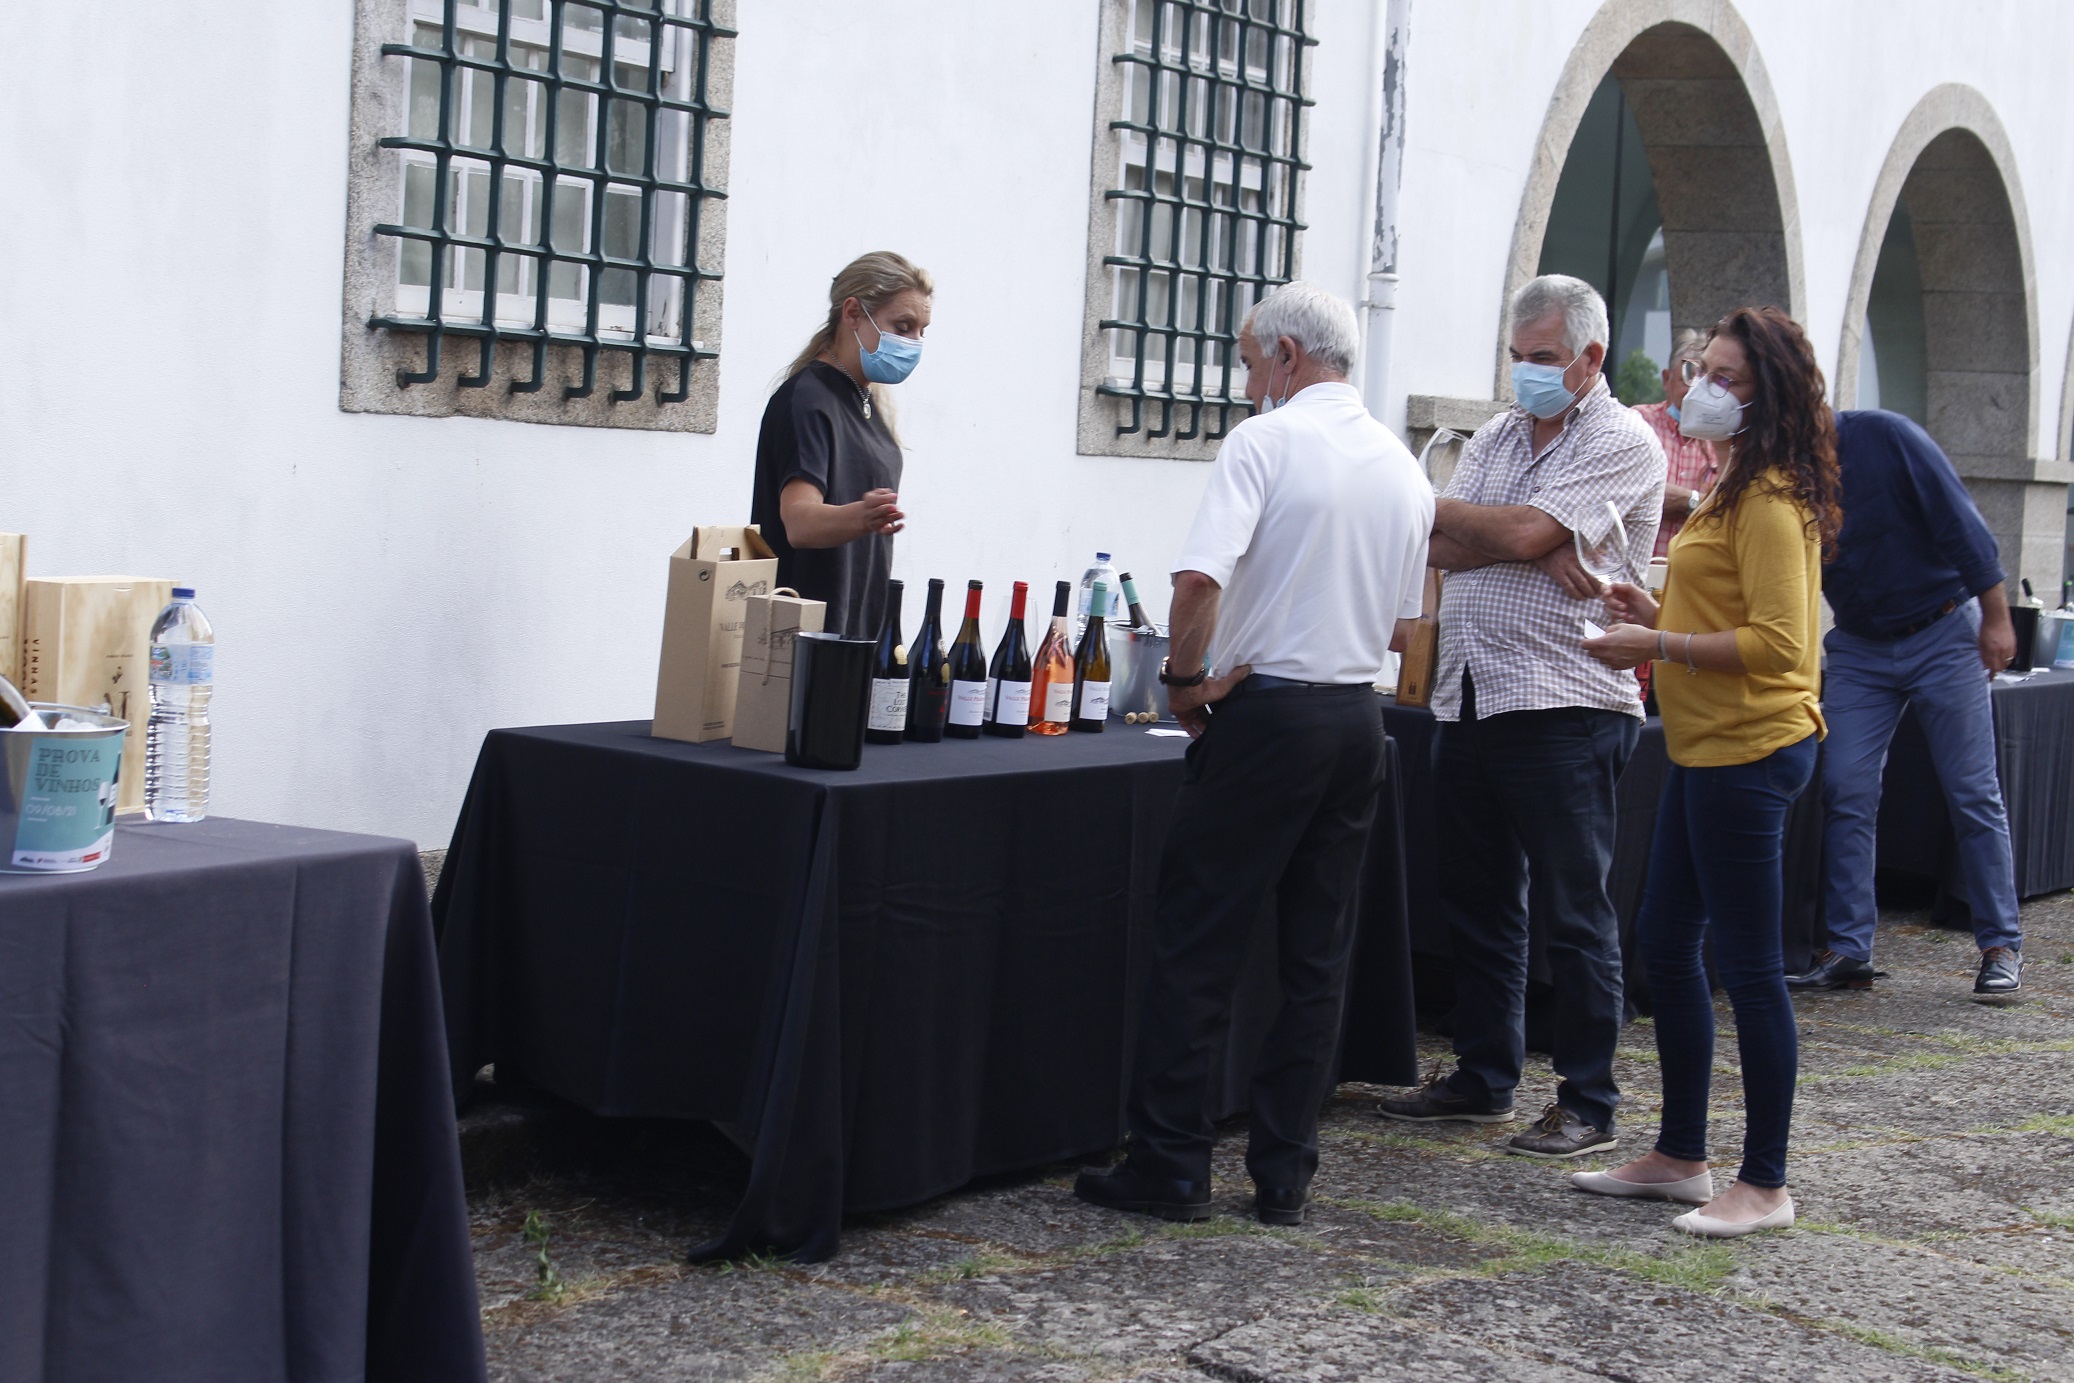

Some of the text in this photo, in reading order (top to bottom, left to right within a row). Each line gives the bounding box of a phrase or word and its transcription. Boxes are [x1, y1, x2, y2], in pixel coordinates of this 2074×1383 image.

[720, 622, 738, 632] VALLE
[37, 747, 101, 763] PROVA
[35, 762, 61, 778] DE
[34, 777, 101, 793] VINHOS
